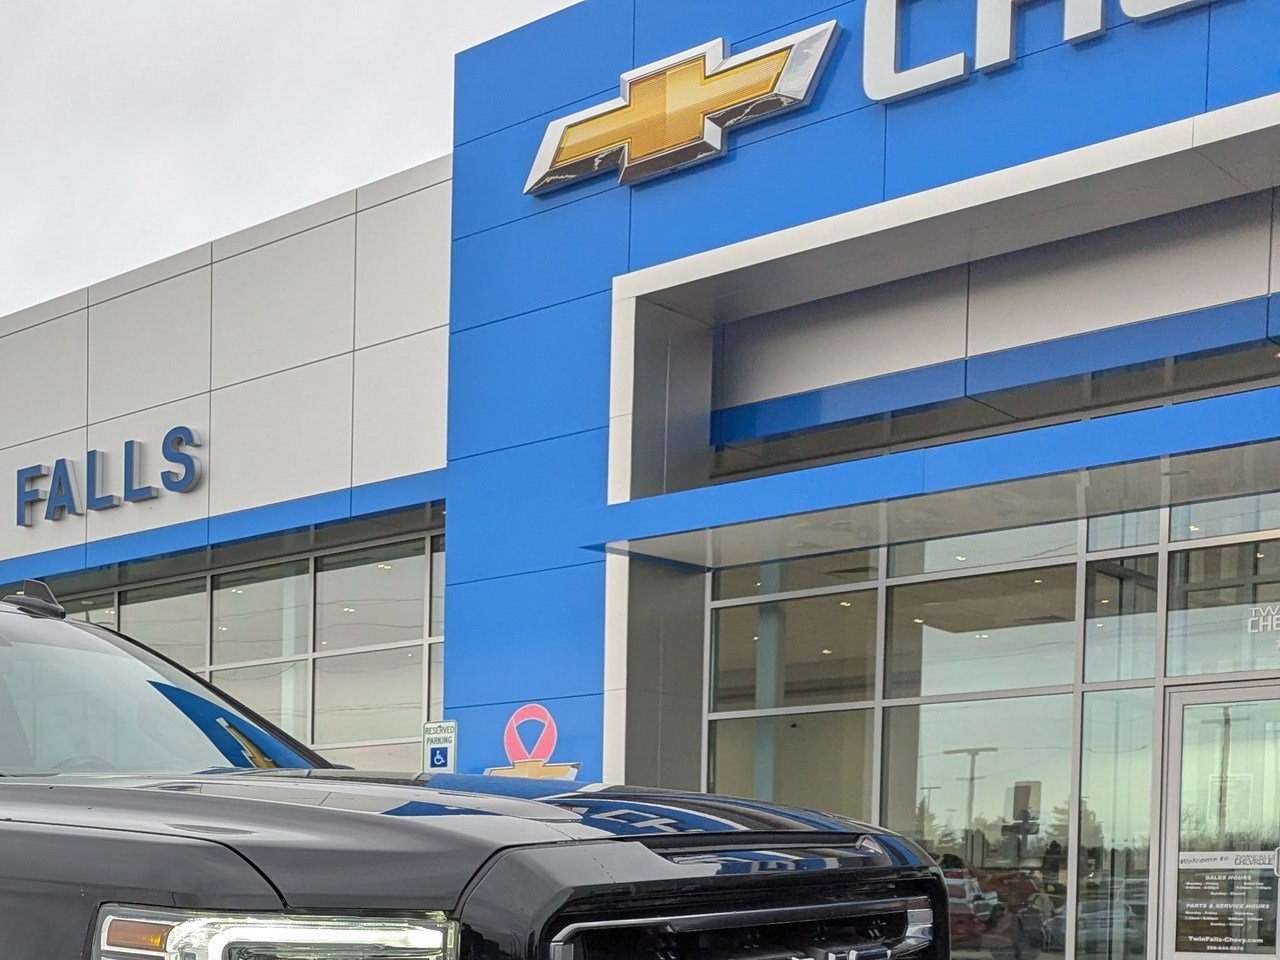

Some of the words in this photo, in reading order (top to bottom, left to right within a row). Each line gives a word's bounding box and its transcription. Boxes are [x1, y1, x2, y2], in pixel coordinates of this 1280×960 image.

[17, 426, 202, 527] FALLS
[425, 726, 455, 735] RESERVED
[427, 736, 452, 745] PARKING
